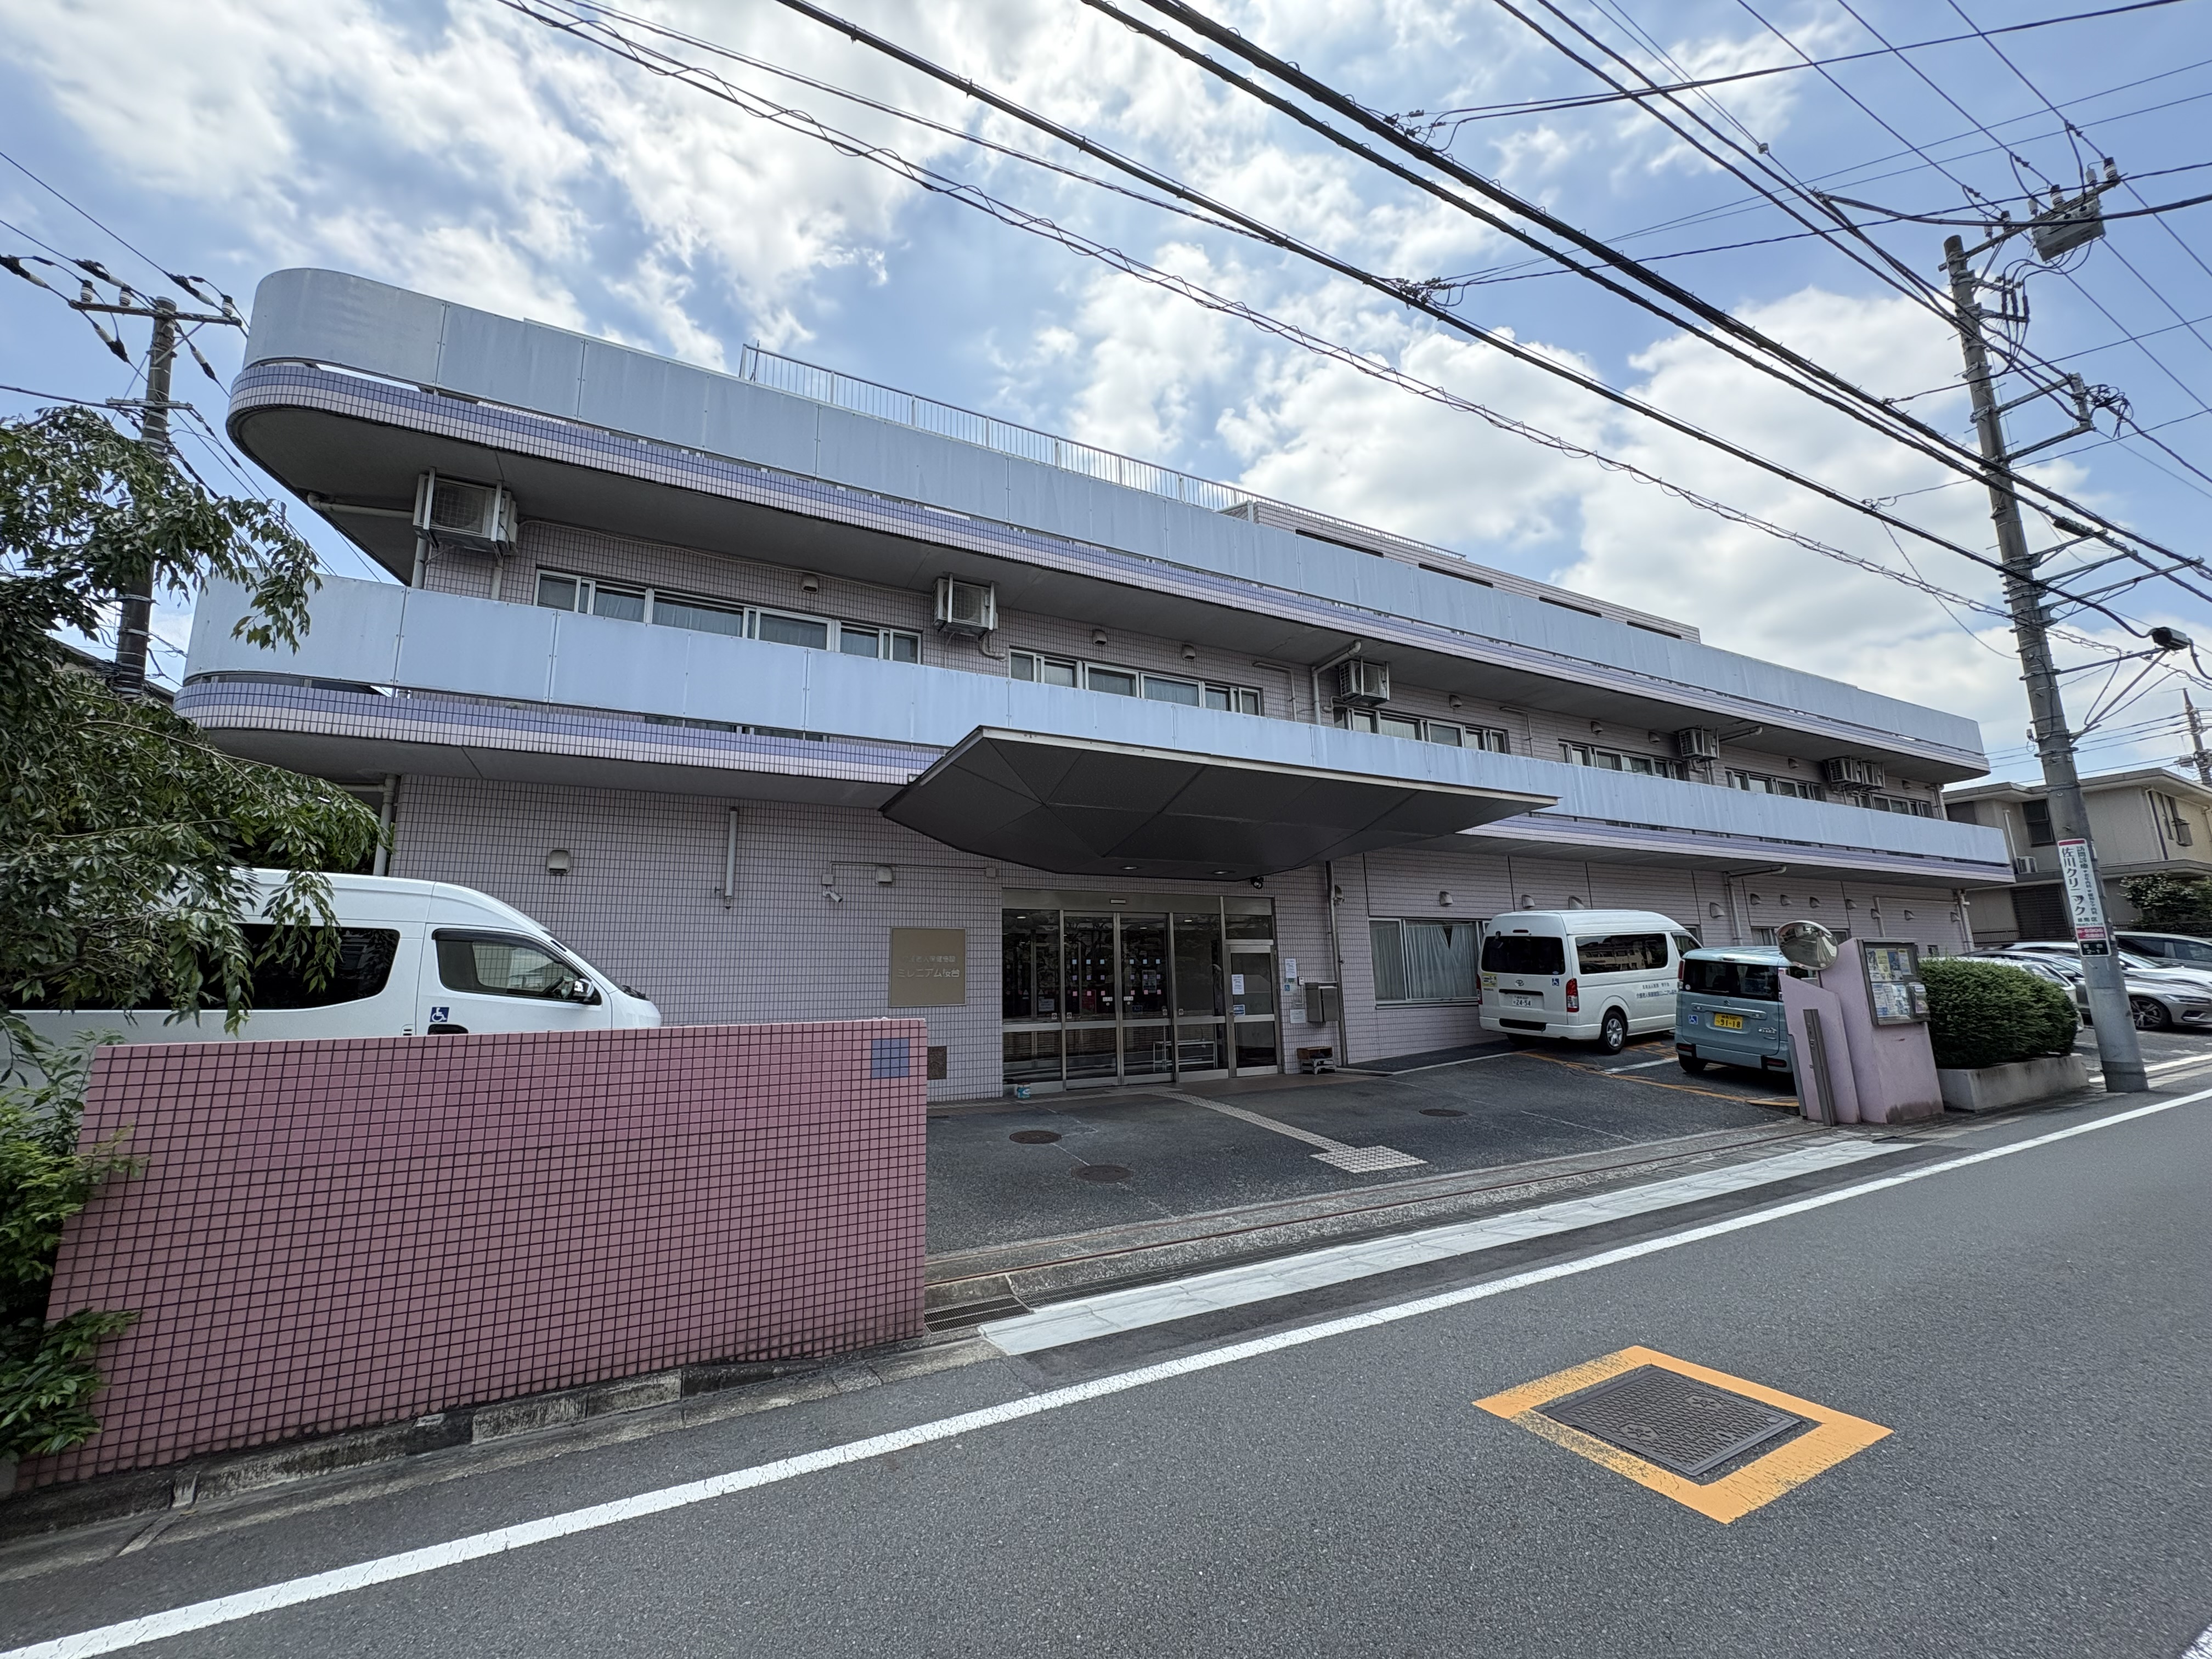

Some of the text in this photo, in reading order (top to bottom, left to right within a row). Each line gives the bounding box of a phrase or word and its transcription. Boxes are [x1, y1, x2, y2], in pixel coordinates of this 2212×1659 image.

[2062, 847, 2085, 916] 佐川クリニック
[897, 968, 960, 978] ミレニアム桜台
[1720, 1019, 1741, 1028] 91-18
